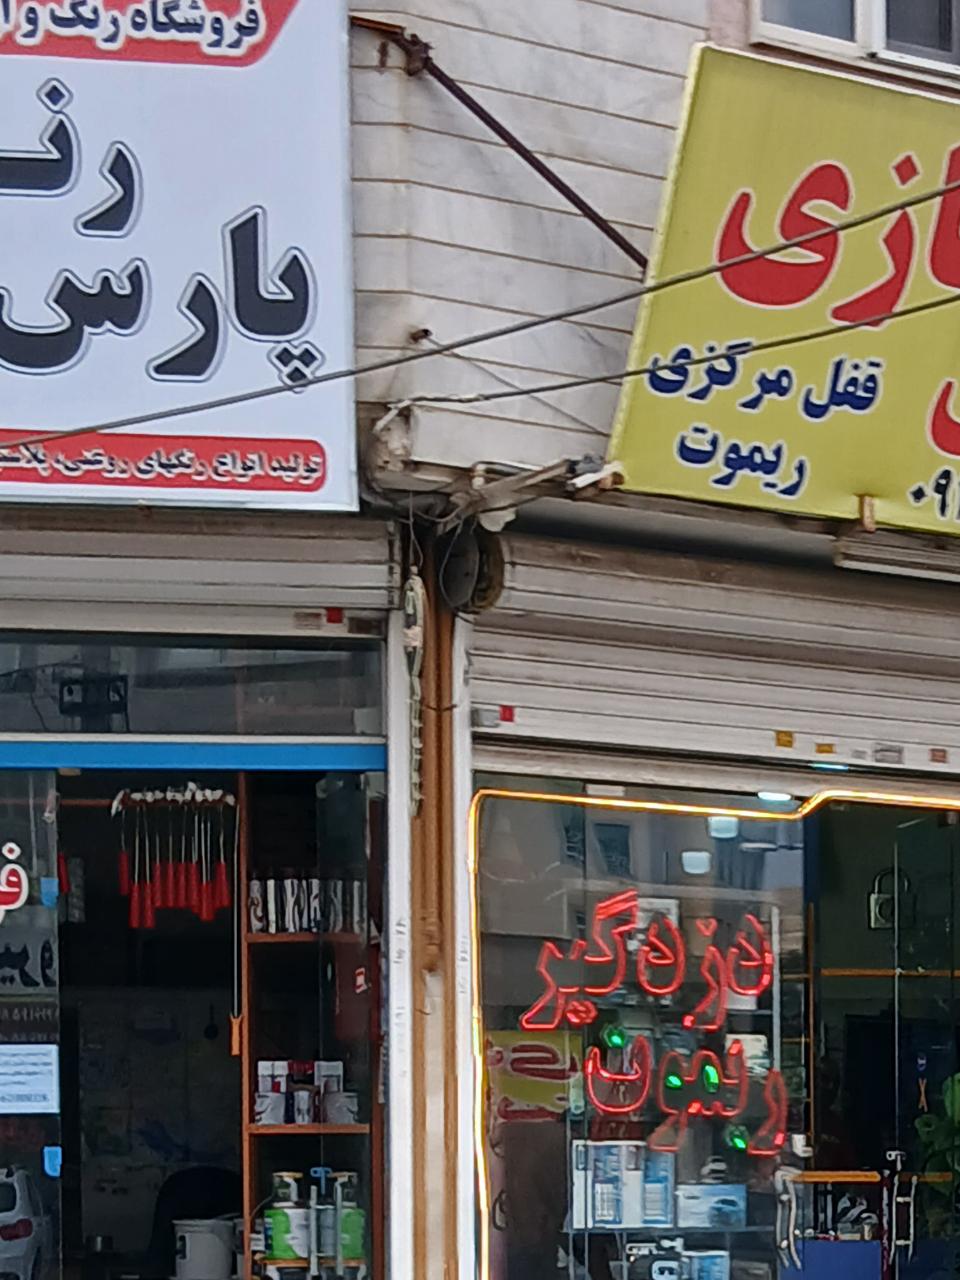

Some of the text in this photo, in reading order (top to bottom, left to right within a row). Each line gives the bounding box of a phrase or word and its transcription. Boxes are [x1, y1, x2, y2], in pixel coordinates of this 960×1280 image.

[20, 5, 40, 38] و
[49, 0, 121, 43] رنگ
[130, 0, 262, 48] فروشگاه
[0, 205, 320, 387] پارس
[648, 341, 882, 419] قفل مرکزی
[677, 425, 807, 496] ریموت
[519, 886, 775, 1031] دزدگیر
[585, 1023, 789, 1156] ریموت
